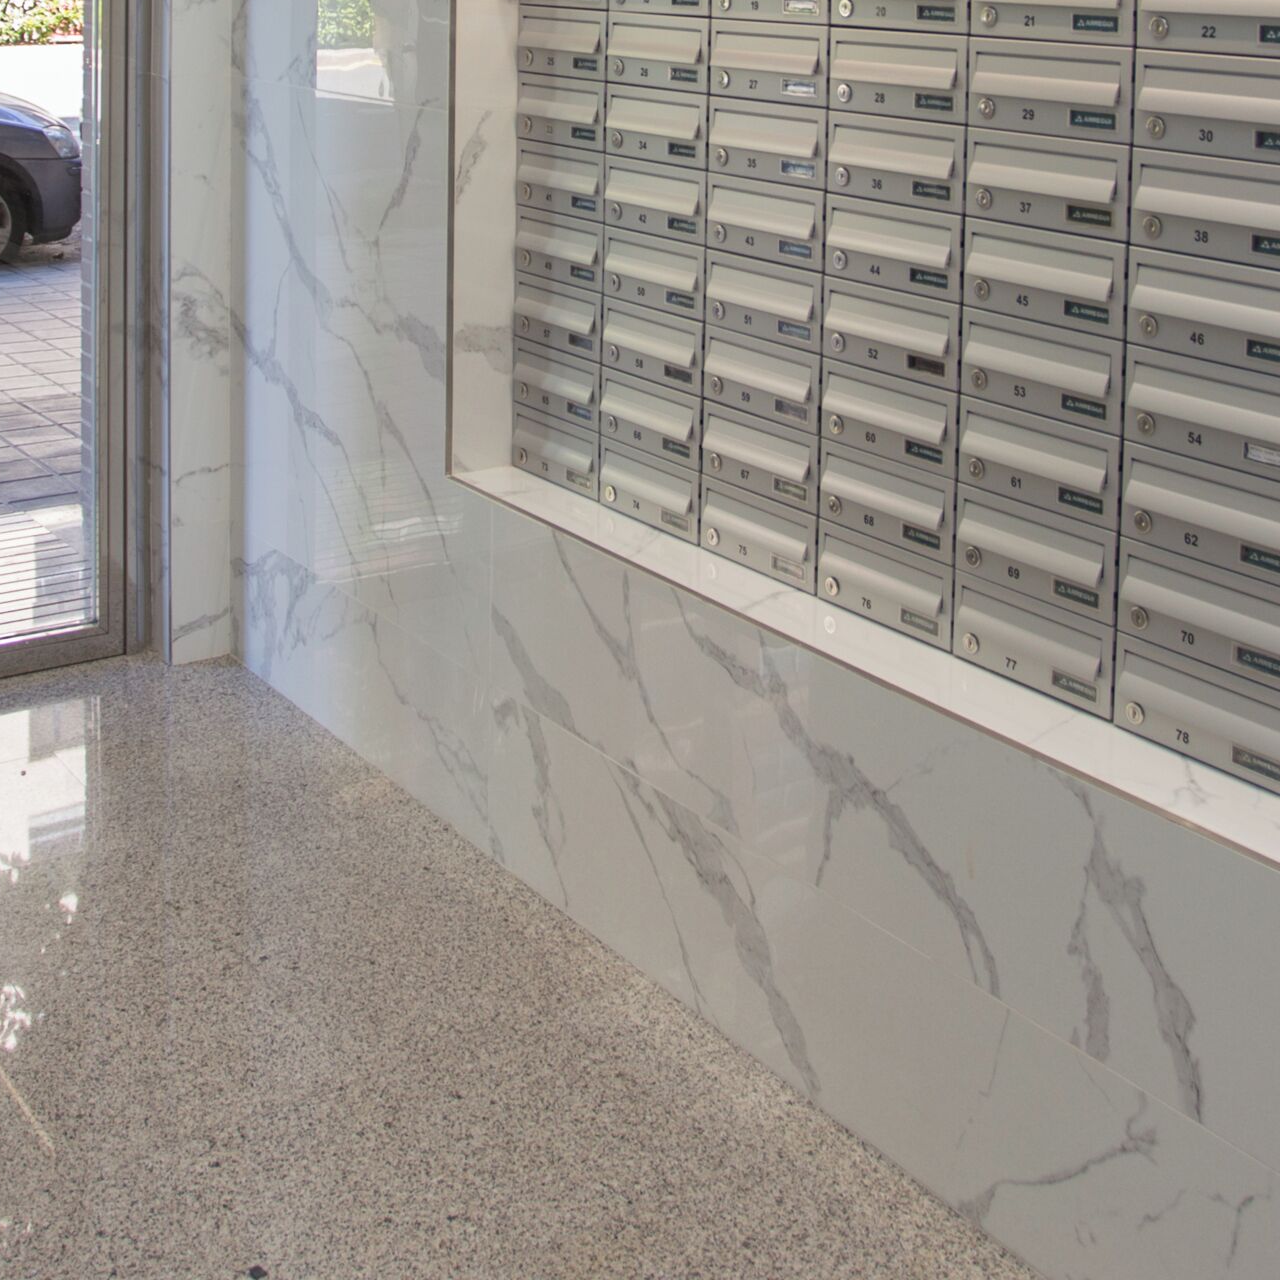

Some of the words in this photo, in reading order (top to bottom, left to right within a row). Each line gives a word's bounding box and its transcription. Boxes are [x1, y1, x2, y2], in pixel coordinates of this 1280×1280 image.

[750, 0, 760, 11] 19
[875, 5, 887, 18] 20
[1023, 14, 1036, 28] 21
[1201, 25, 1217, 39] 22
[748, 79, 759, 90] 27
[874, 91, 886, 104] 28
[1021, 107, 1035, 121] 29
[1198, 128, 1214, 143] 30
[746, 157, 757, 169] 35
[871, 178, 883, 191] 36
[1019, 201, 1032, 214] 37
[744, 235, 755, 247] 43
[1194, 229, 1209, 244] 38
[869, 264, 881, 276] 44
[1015, 294, 1029, 307] 45
[743, 313, 753, 326] 51
[1189, 331, 1205, 346] 46
[867, 347, 879, 361] 52
[741, 391, 751, 403] 59
[1013, 384, 1027, 399] 53
[864, 431, 877, 444] 60
[1187, 431, 1203, 447] 54
[740, 468, 750, 481] 67
[1010, 475, 1022, 489] 61
[863, 513, 875, 527] 68
[1183, 532, 1199, 548] 62
[738, 543, 748, 557] 75
[1007, 565, 1021, 580] 69
[861, 596, 872, 610] 76
[1180, 629, 1195, 646] 70
[1005, 656, 1018, 671] 77
[1175, 728, 1190, 745] 78
